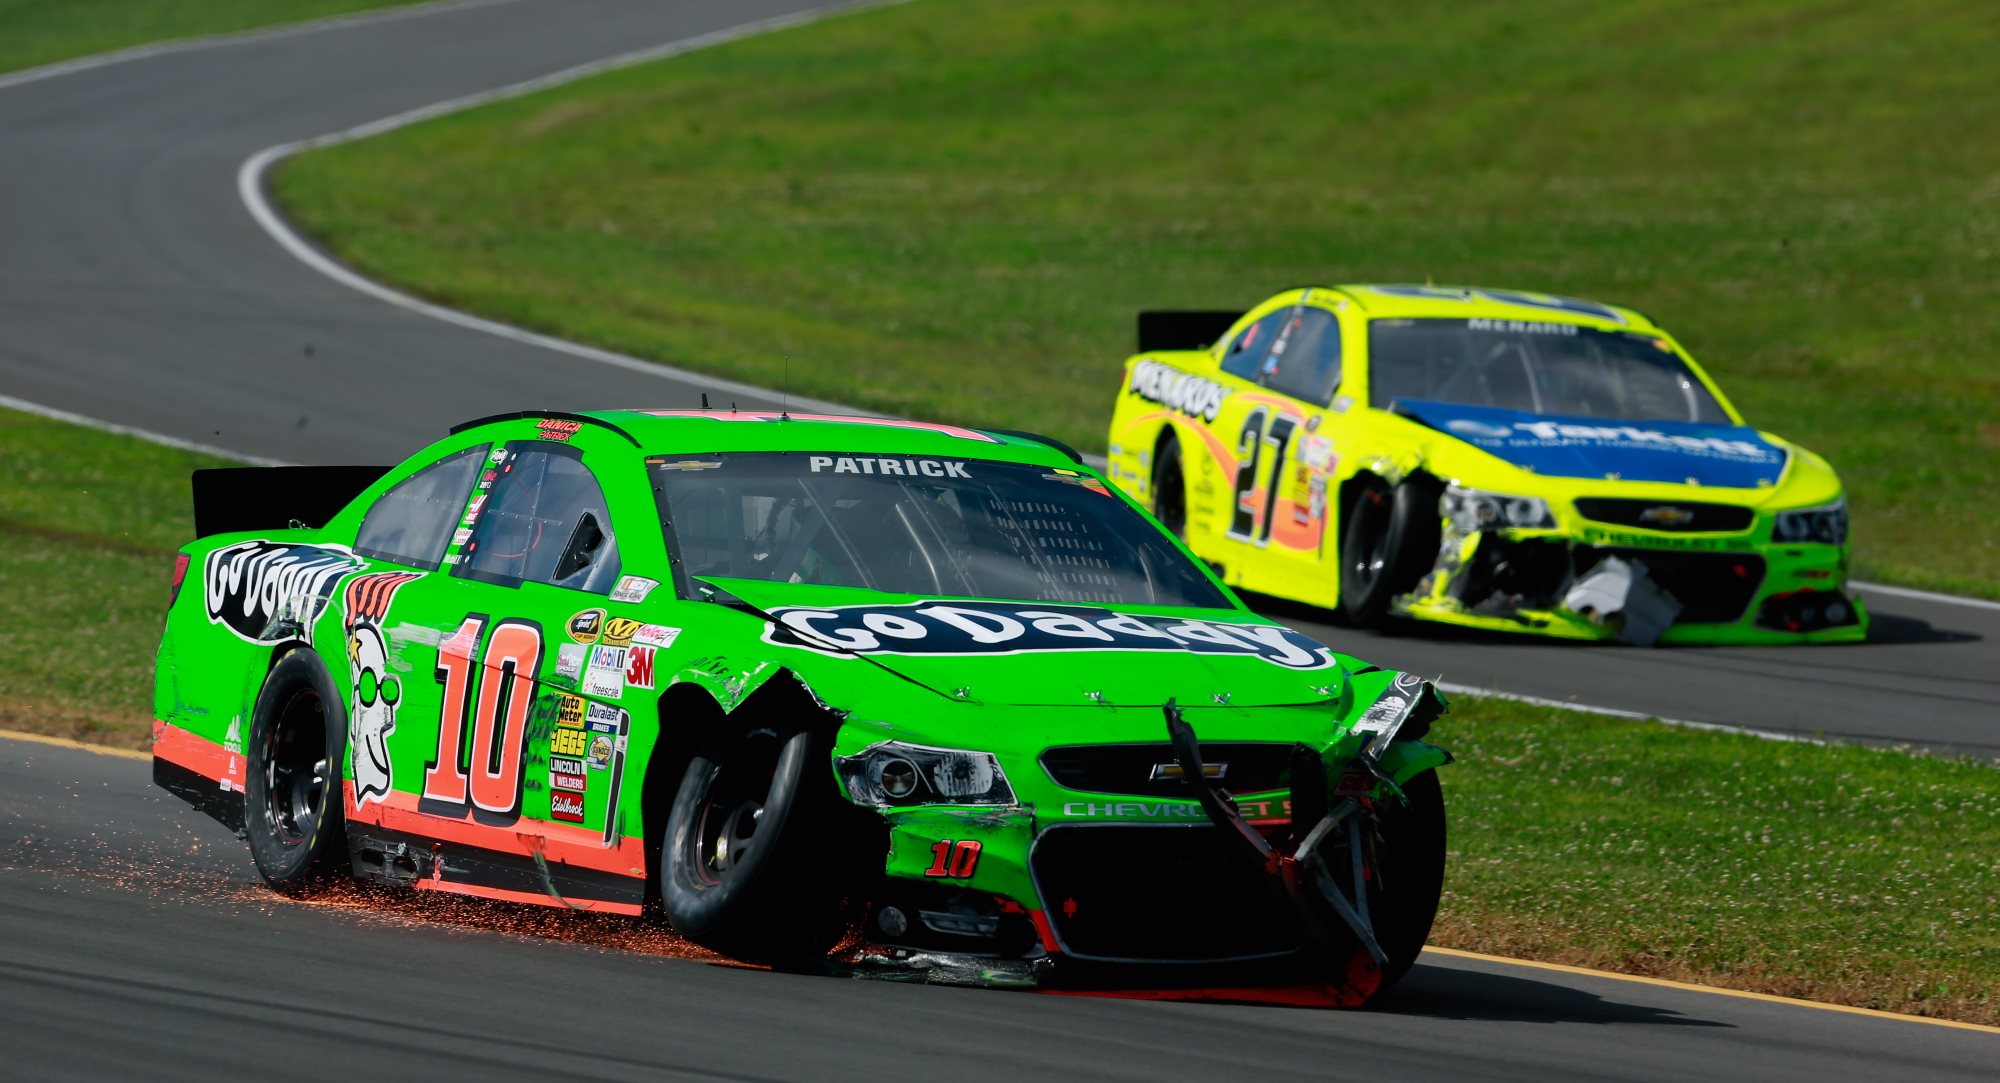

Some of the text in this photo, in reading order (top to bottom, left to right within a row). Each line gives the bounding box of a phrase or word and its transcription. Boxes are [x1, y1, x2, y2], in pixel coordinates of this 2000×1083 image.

[1467, 318, 1578, 336] MENARD
[536, 419, 583, 432] DANICA
[809, 456, 974, 479] PATRICK
[1228, 405, 1301, 547] 27
[592, 646, 616, 667] Mobil
[616, 649, 626, 668] 1
[627, 646, 656, 687] 3M
[592, 683, 619, 697] freescale
[561, 696, 579, 709] Auto
[420, 614, 544, 822] 10
[557, 709, 582, 723] Meter
[588, 705, 618, 721] Duralast
[551, 728, 587, 756] JEGS
[550, 758, 581, 775] LINCOLN
[557, 775, 583, 789] WELDERS
[551, 795, 583, 817] Edelbrock
[1063, 800, 1272, 817] CHEVRET
[925, 838, 983, 878] 10
